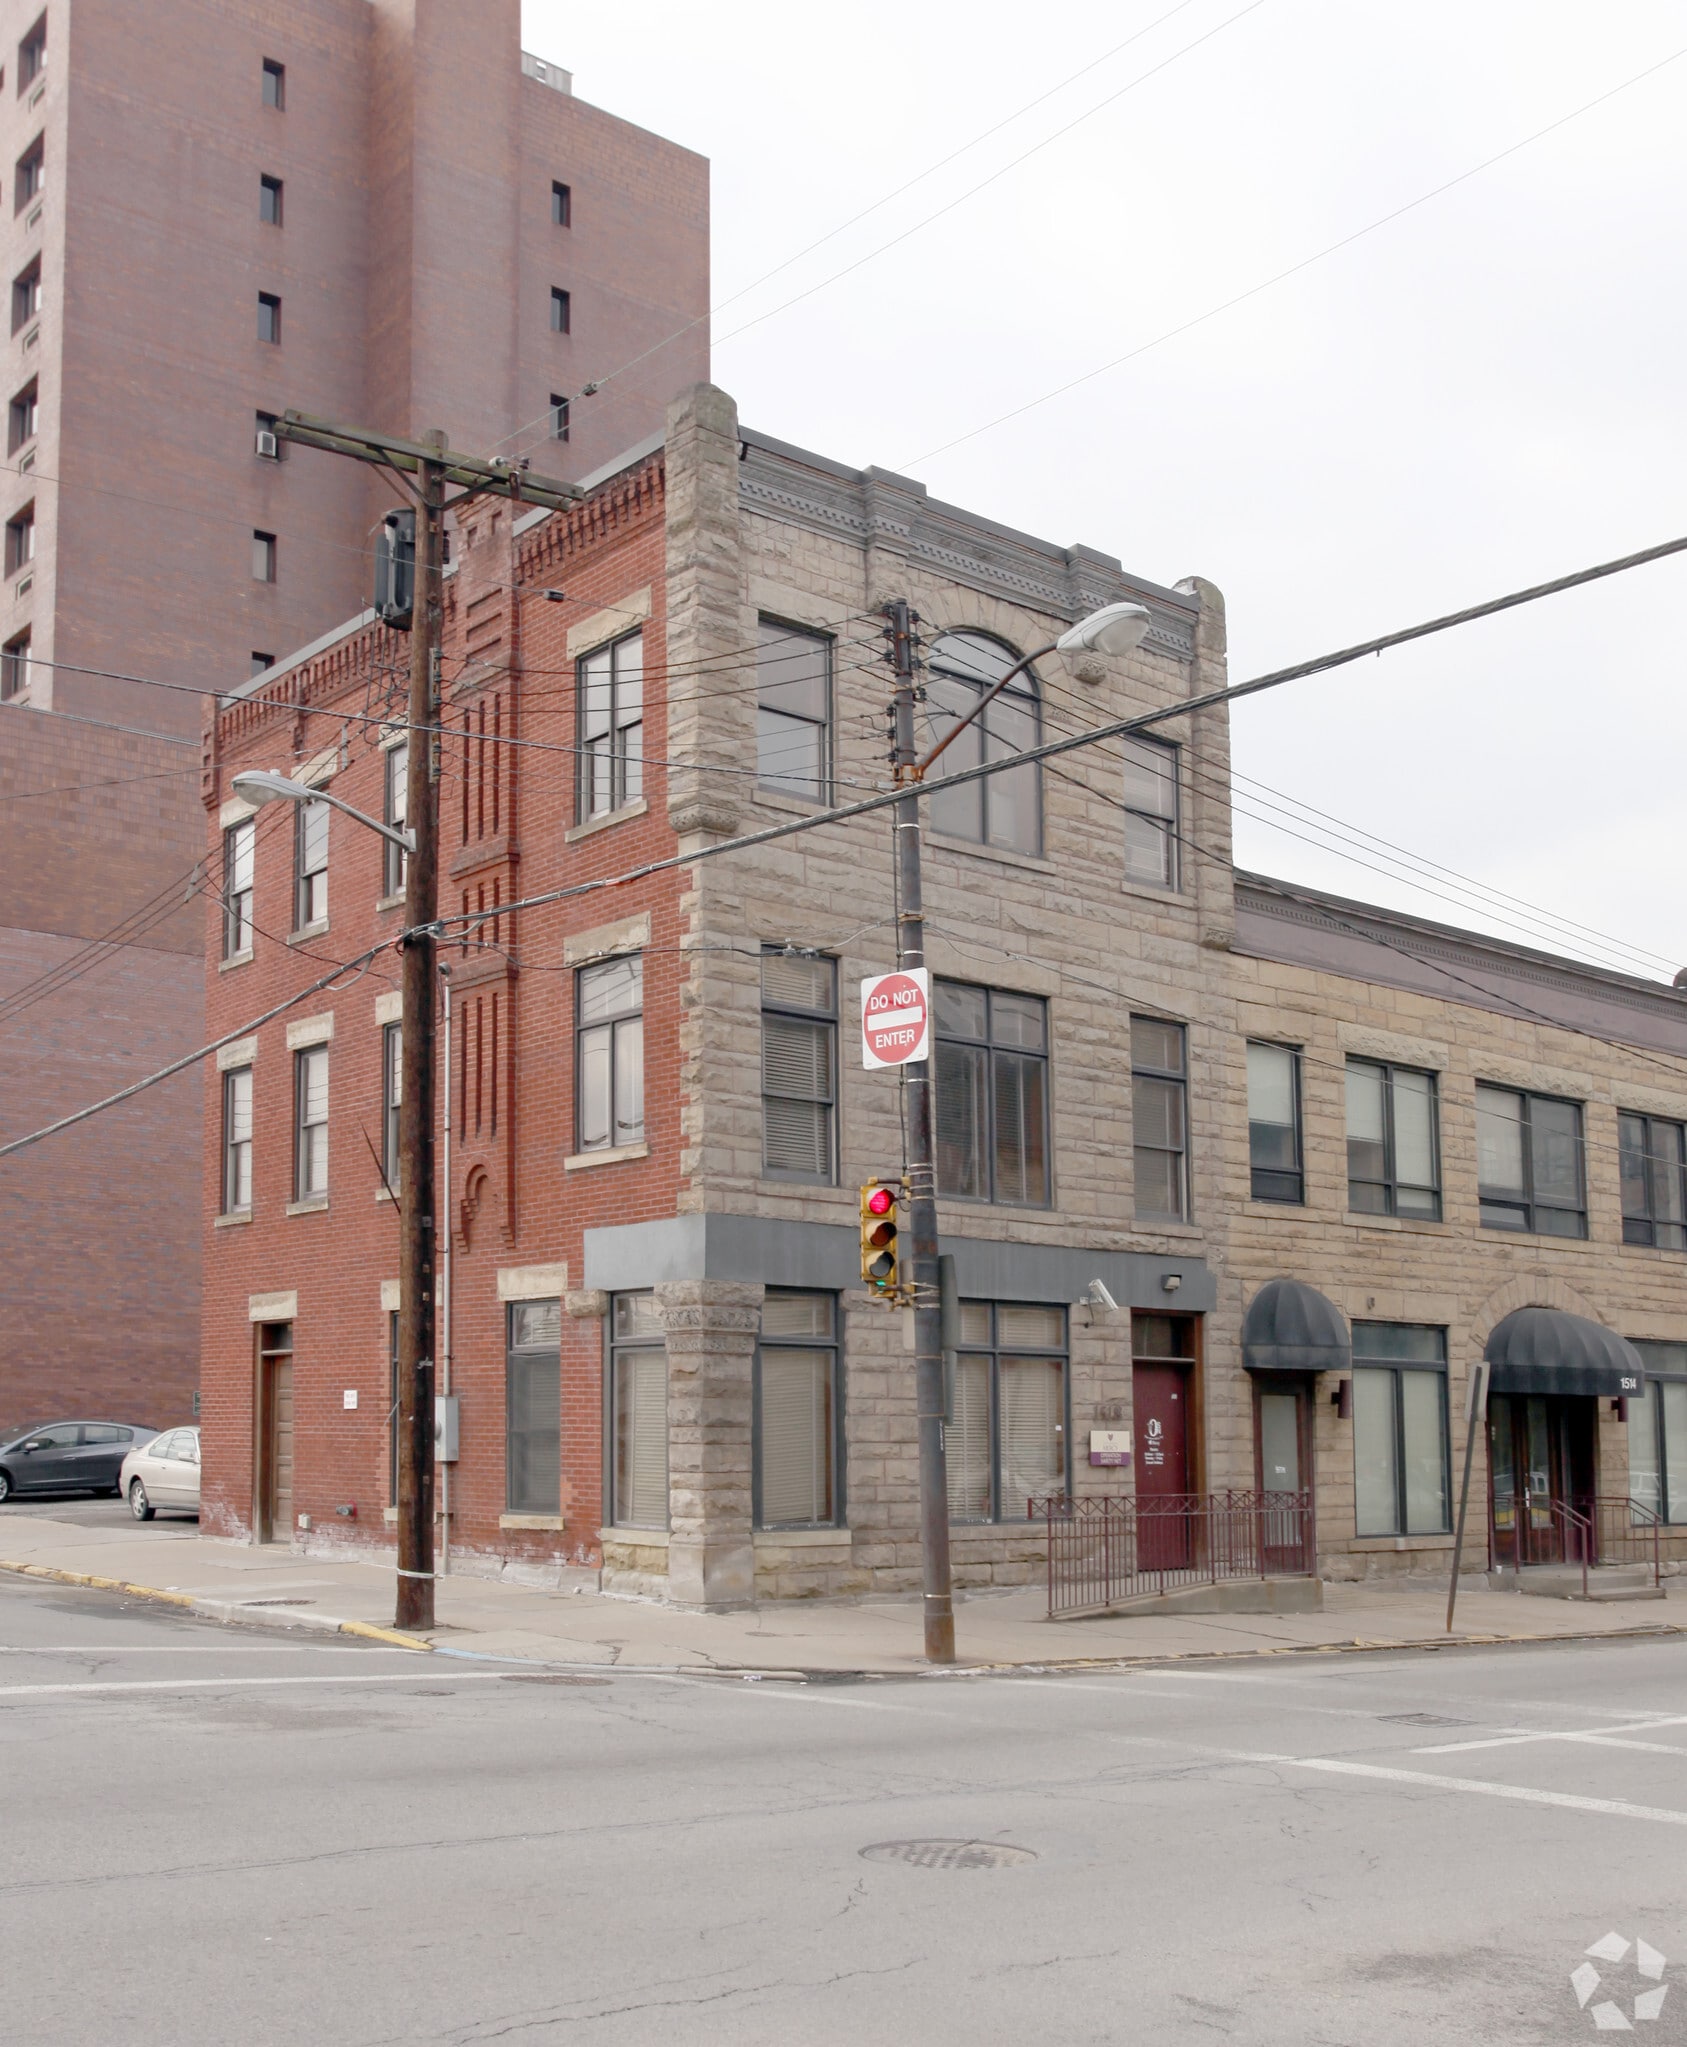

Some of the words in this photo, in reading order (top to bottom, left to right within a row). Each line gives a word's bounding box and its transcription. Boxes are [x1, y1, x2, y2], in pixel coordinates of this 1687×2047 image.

[870, 995, 888, 1010] DO
[893, 988, 918, 1006] NOT
[875, 1029, 915, 1048] ENTER
[1620, 1377, 1636, 1389] 1514
